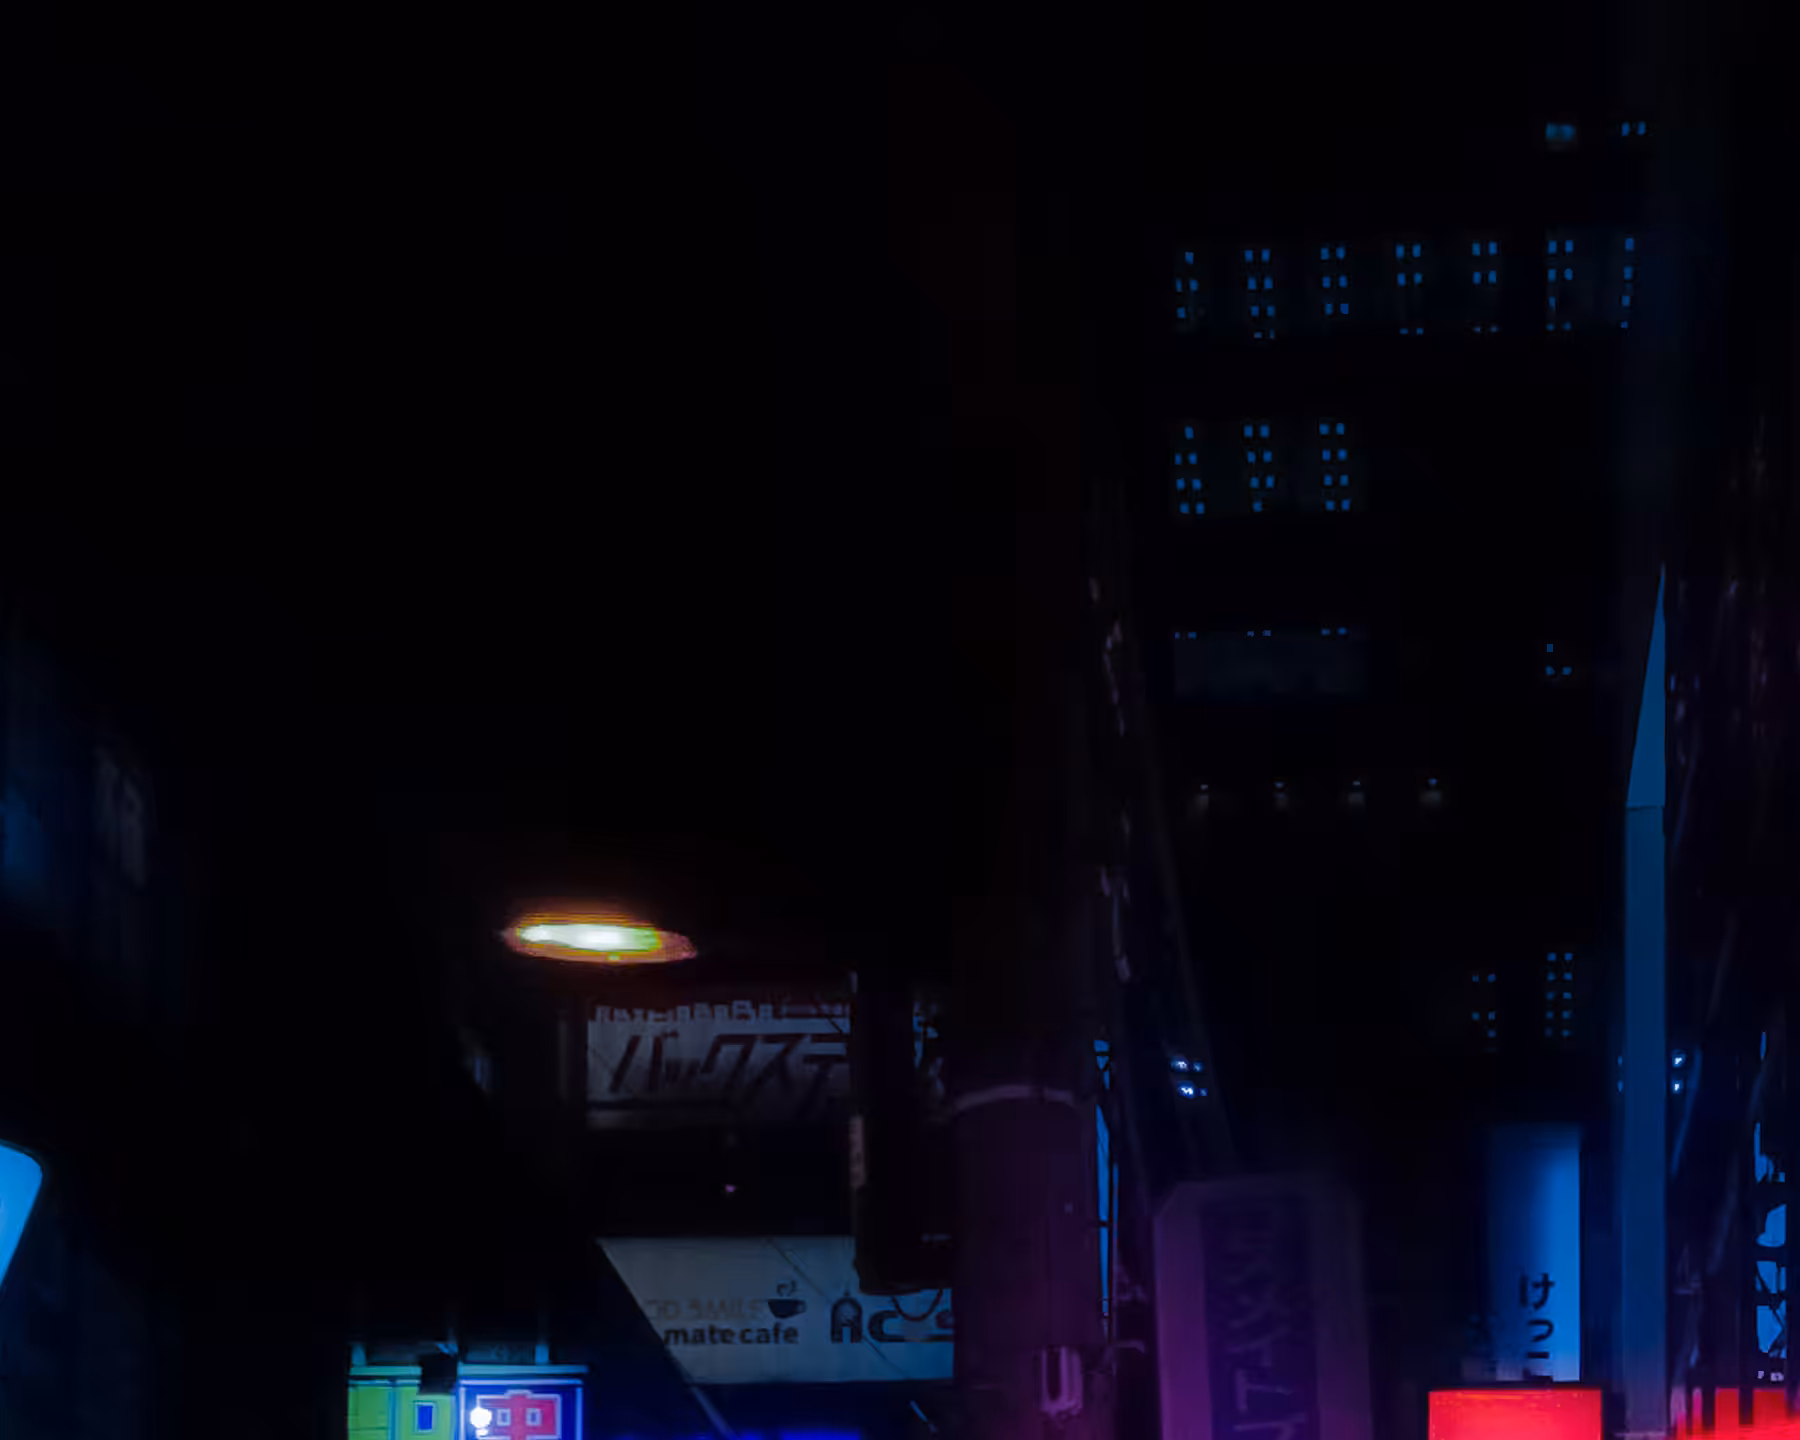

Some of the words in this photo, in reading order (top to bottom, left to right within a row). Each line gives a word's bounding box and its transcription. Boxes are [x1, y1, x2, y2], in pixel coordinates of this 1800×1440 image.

[609, 1033, 853, 1118] バックステ
